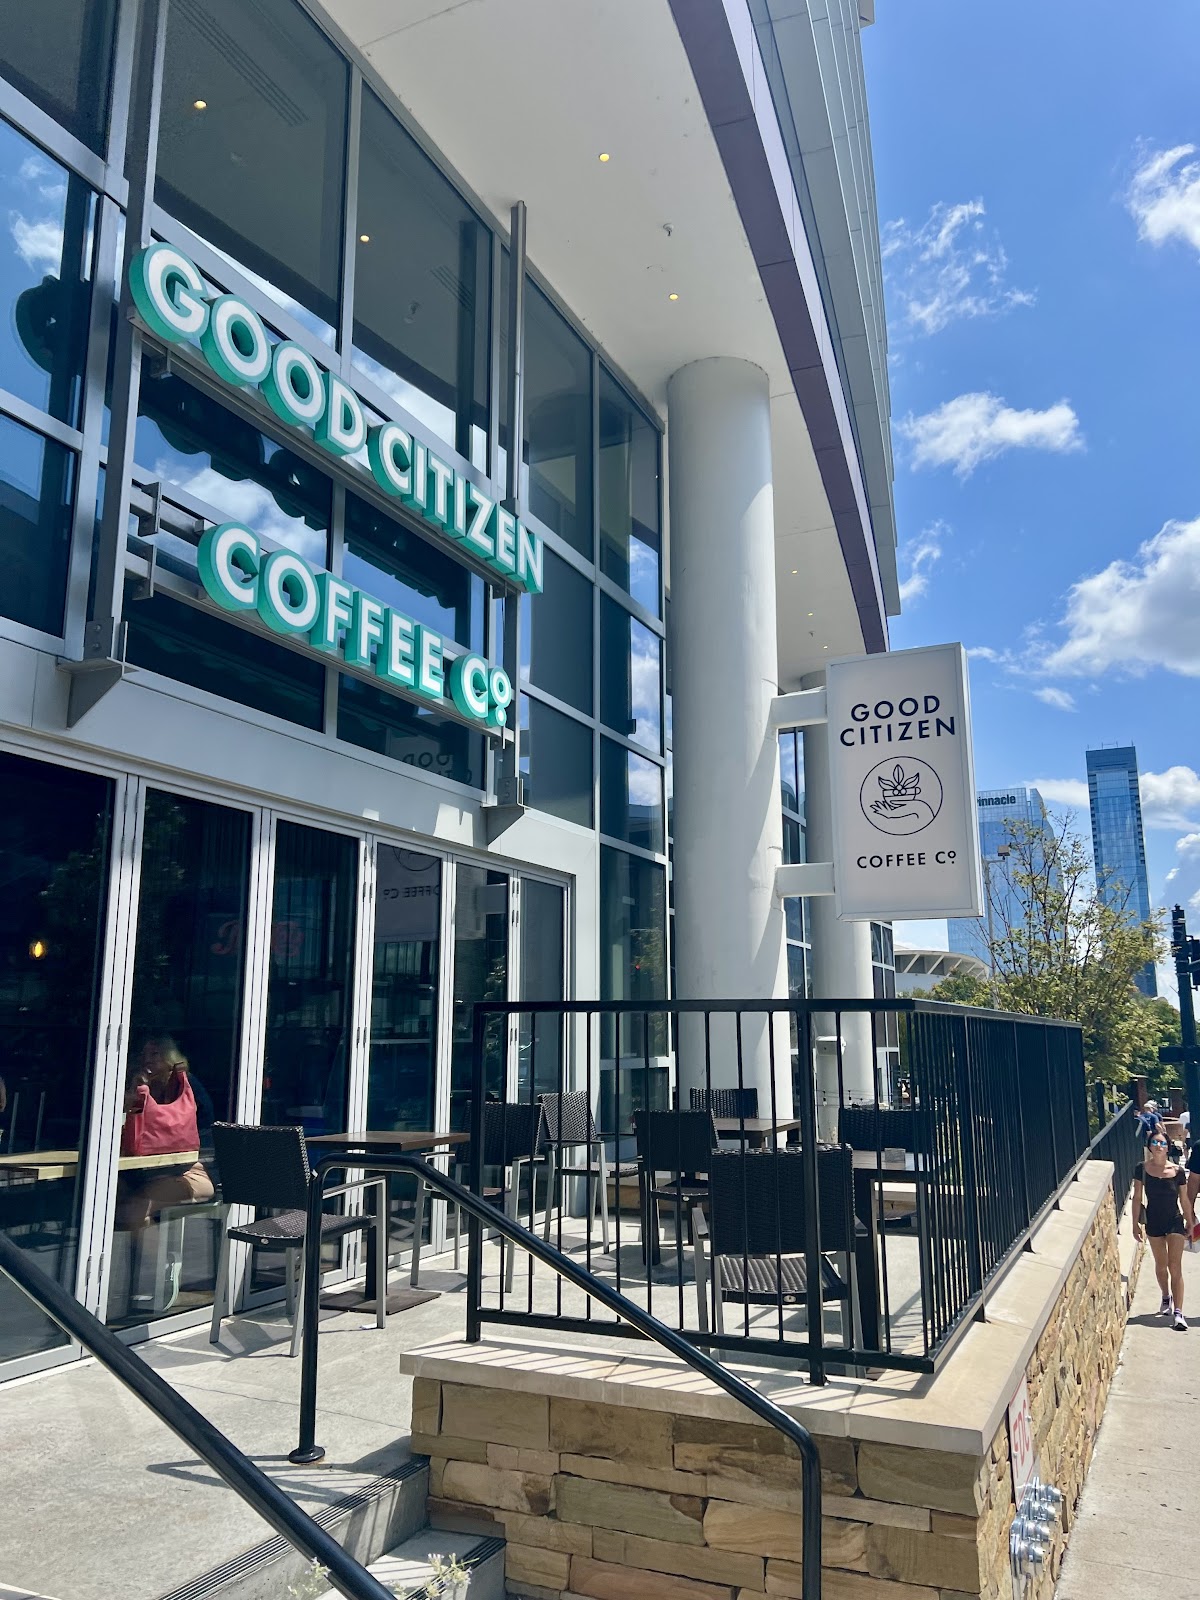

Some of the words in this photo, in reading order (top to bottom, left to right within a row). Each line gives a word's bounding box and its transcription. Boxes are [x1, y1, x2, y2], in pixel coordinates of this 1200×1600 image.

[130, 242, 367, 456] GOOD
[367, 420, 544, 594] CITIZEN
[197, 522, 443, 700] COFFEE
[851, 695, 940, 722] GOOD
[840, 716, 955, 747] CITIZEN
[977, 794, 1016, 806] innacle
[857, 852, 926, 869] COFFEE
